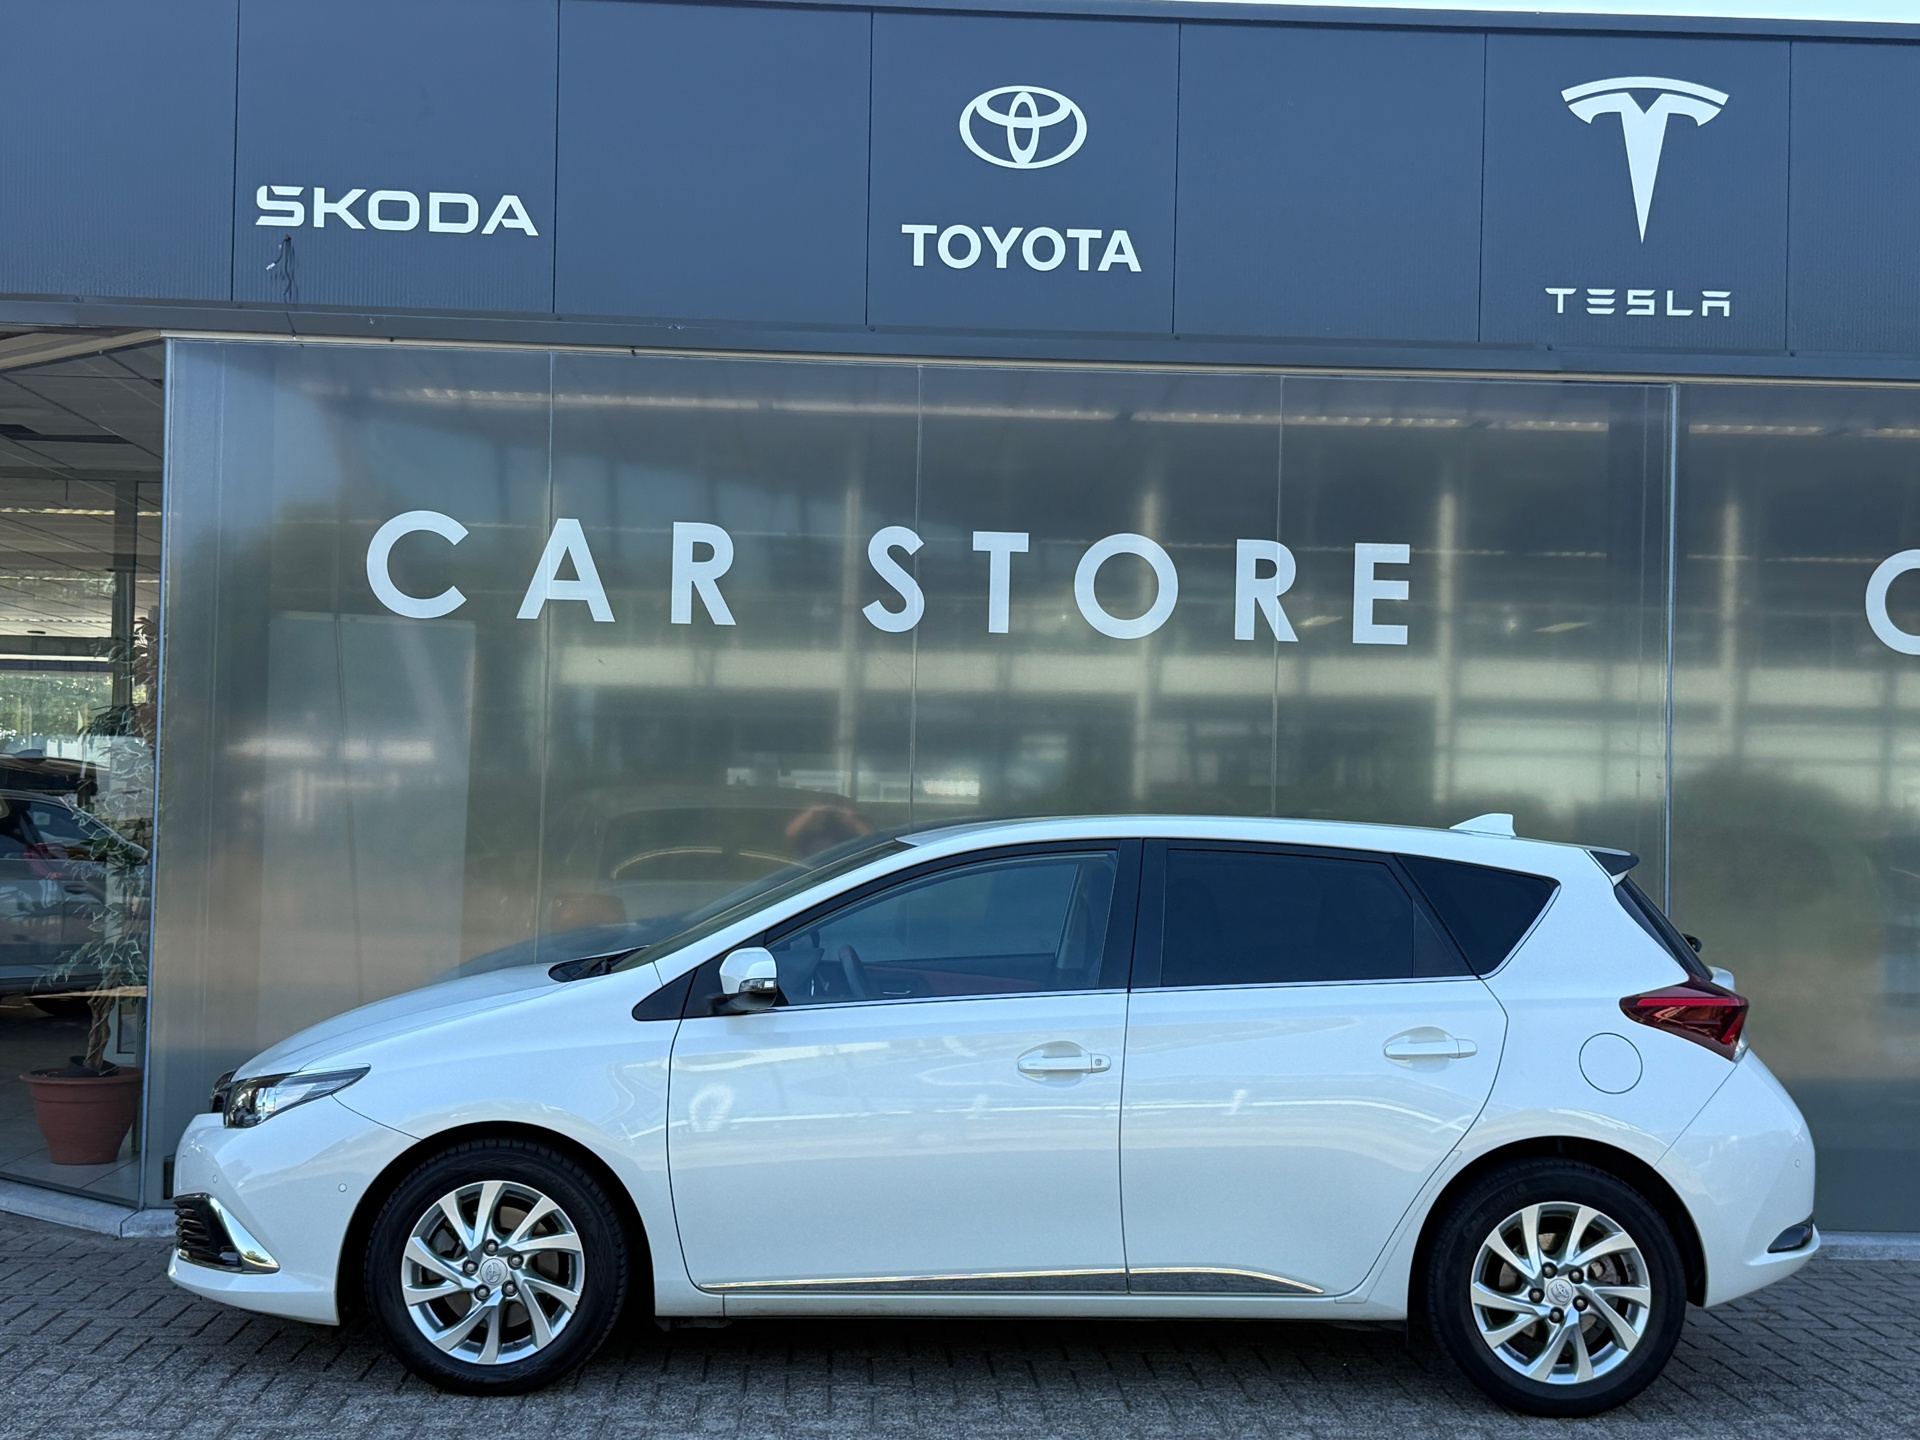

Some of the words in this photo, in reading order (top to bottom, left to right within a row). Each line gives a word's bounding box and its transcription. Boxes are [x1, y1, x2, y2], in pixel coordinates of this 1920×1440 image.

[901, 223, 1142, 273] TOYOTA
[1545, 287, 1732, 318] TESLA
[366, 510, 737, 626] CAR
[862, 525, 1411, 646] STORE
